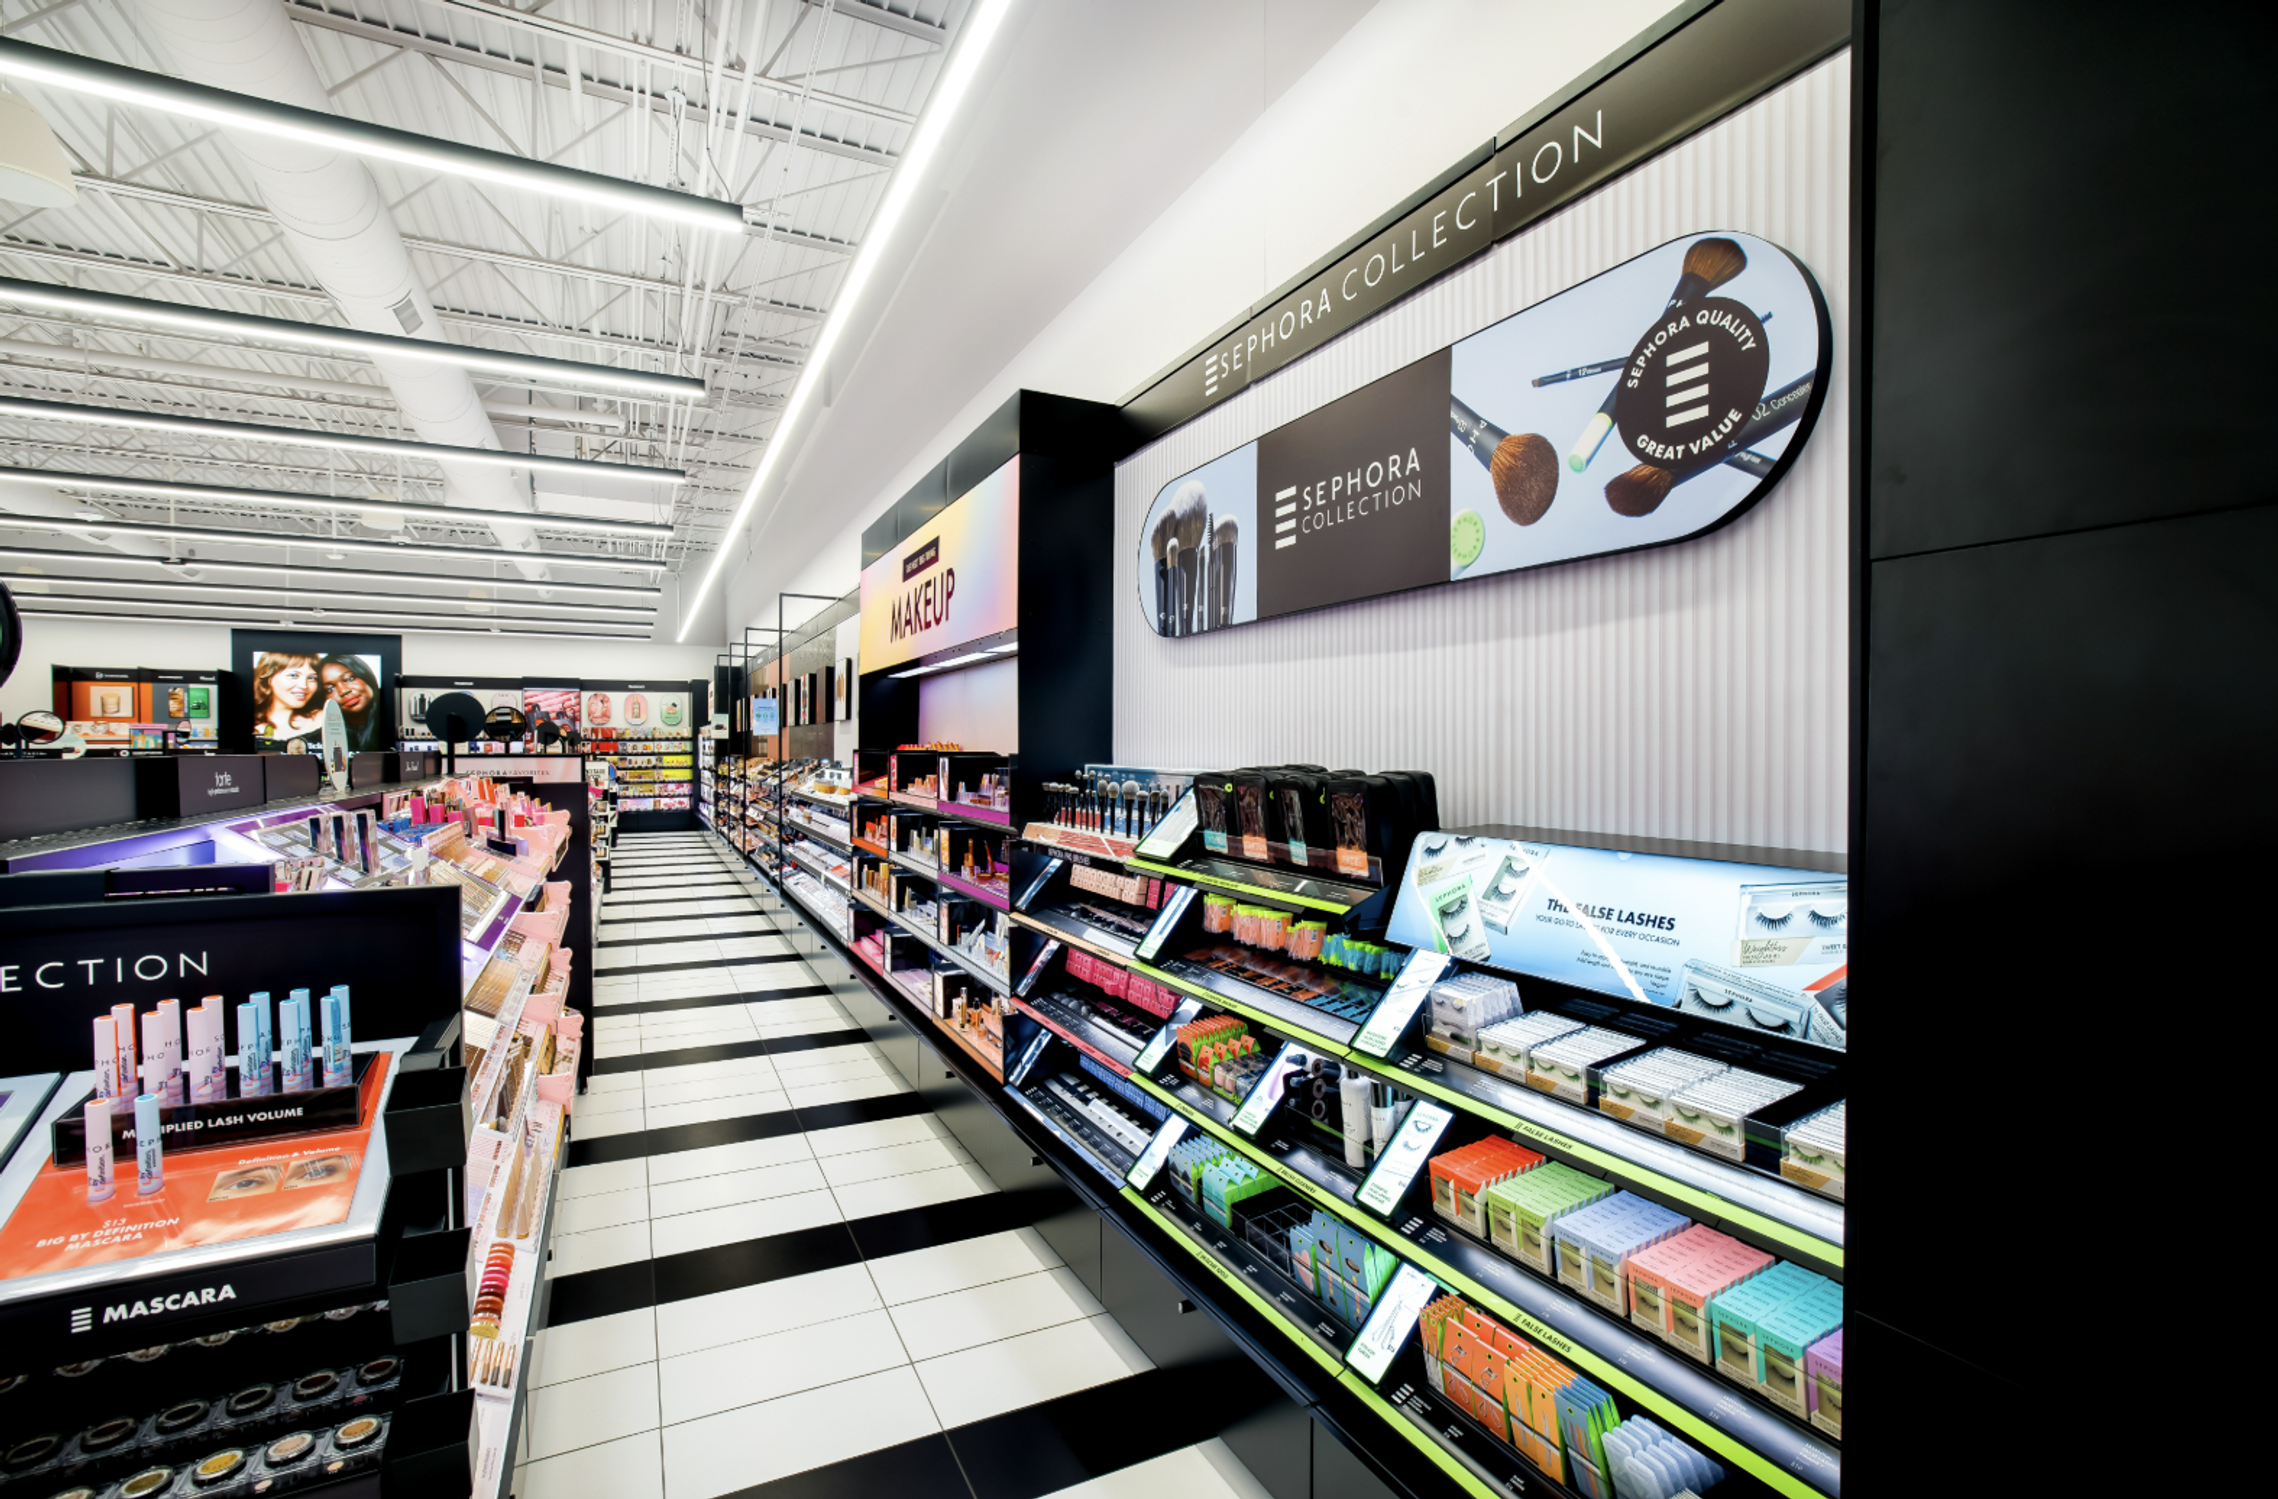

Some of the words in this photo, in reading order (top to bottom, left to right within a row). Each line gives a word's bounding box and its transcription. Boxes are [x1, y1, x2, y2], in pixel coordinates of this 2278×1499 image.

[1219, 287, 1332, 379] SEPHORA
[1341, 108, 1603, 302] COLLECTION
[1626, 315, 1691, 389] SEPHORA
[1695, 309, 1757, 351] QUALITY
[1636, 434, 1686, 460] GREAT
[1688, 407, 1743, 455] VALUE
[1302, 447, 1421, 511] SEPHORA
[1301, 478, 1422, 534] COLLECTION
[889, 566, 956, 644] MAKEUP
[1434, 882, 1467, 903] SEPHORA
[1616, 909, 1676, 931] LASHES
[1615, 928, 1638, 940] EVERY
[1638, 932, 1681, 947] OCCASION
[0, 951, 209, 993] ECTION
[1724, 988, 1753, 1004] SEPHORA
[122, 1119, 205, 1141] MIPLIED
[207, 1114, 244, 1129] LASH
[246, 1106, 304, 1123] VOLUME
[237, 1153, 290, 1166] Definition
[291, 1150, 300, 1158] &
[302, 1146, 342, 1156] Volume
[1543, 1133, 1574, 1150] LASHES
[36, 1235, 66, 1249] BIG
[68, 1231, 91, 1243] BY
[92, 1217, 180, 1239] DEFINITION
[102, 1217, 128, 1229] $13
[63, 1231, 144, 1252] MASCARA
[103, 1284, 237, 1325] MASCARA
[1717, 1310, 1749, 1330] SEPHORA
[1520, 1318, 1545, 1336] FALSE
[1542, 1331, 1573, 1353] LASHES
[1761, 1333, 1795, 1354] SEPHORA
